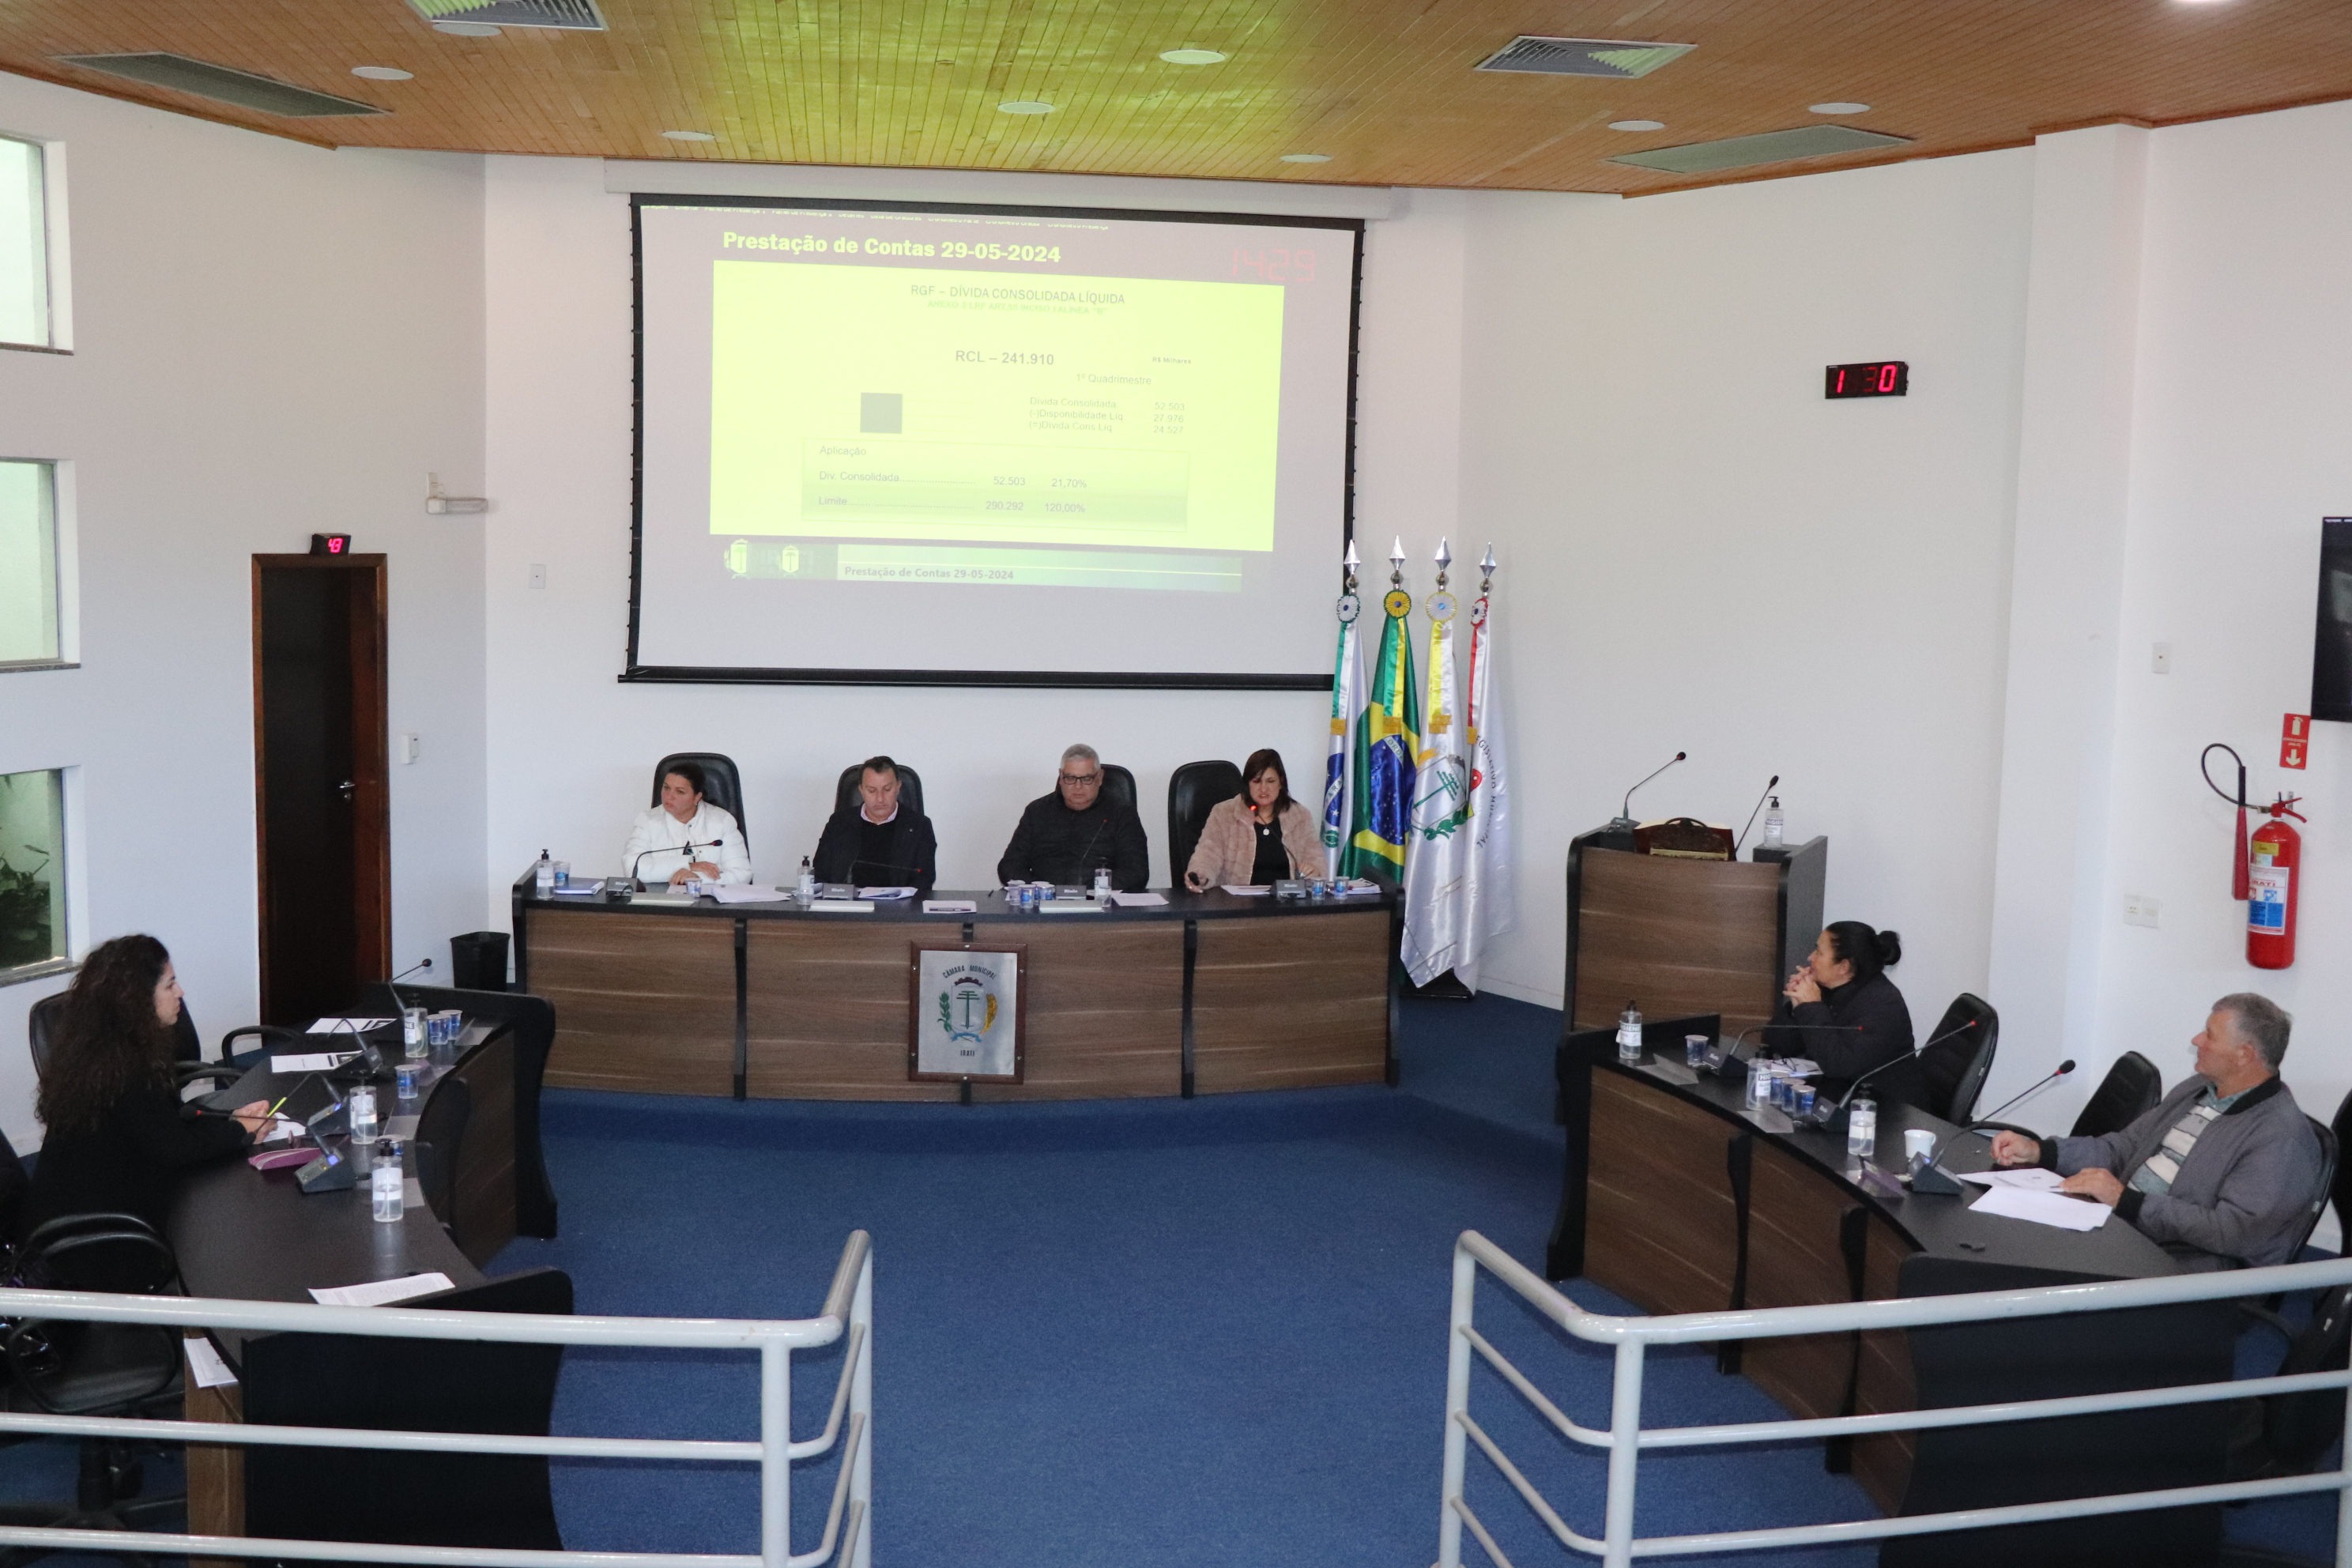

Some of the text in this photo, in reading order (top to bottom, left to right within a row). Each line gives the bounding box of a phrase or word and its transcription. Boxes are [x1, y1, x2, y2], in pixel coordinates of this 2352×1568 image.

[723, 232, 1061, 262] Prestação de Contas 29-05-2024
[910, 285, 936, 296] RGF
[950, 285, 989, 299] DÍVIDA
[992, 288, 1076, 303] CONSOLIDADA
[1079, 289, 1125, 305] LÍQUIDA
[927, 300, 959, 309] ANEXO
[969, 302, 986, 311] LRF
[1020, 303, 1050, 313] INCISO
[955, 350, 985, 363] RCL
[1001, 352, 1054, 366] 241.910
[1163, 356, 1192, 365] Milhares
[1087, 374, 1152, 386] Quadrimestre
[1030, 396, 1058, 406] Dívida
[1155, 401, 1185, 412] 52.503
[1153, 413, 1184, 424] 27.976
[1153, 424, 1184, 435] 24.527
[820, 445, 867, 458] Aplicação
[820, 471, 837, 481] Div.
[993, 476, 1026, 487] 52.503
[1051, 477, 1087, 488] 21,70%
[986, 500, 1024, 511] 290.292
[1045, 503, 1086, 514] 120,00%
[844, 565, 1014, 581] Prestação de Contas 29-05-2024
[969, 965, 997, 980] MUNICIPAL
